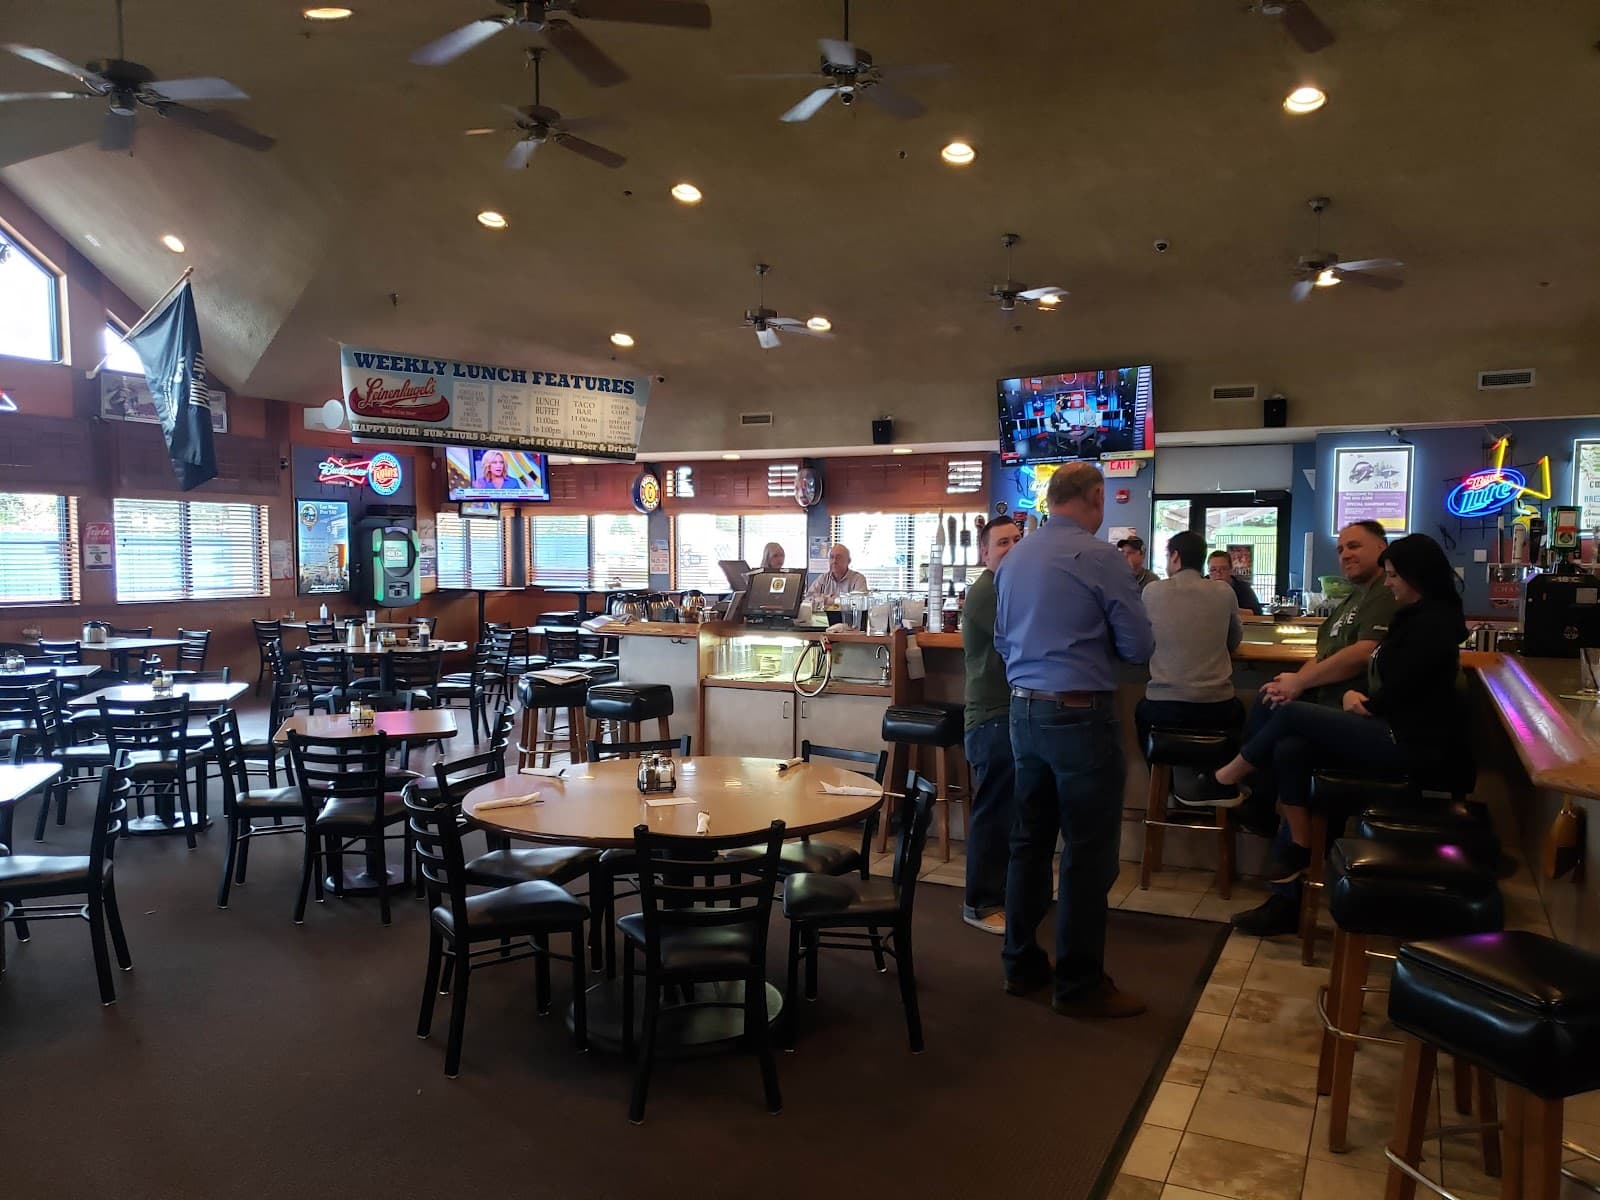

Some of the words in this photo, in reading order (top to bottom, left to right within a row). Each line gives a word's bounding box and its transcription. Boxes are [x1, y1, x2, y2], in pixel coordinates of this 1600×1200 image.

[353, 352, 447, 376] WEEKLY
[453, 363, 527, 384] LUNCH
[532, 371, 635, 395] FEATURES
[536, 396, 560, 407] LUNCH
[572, 400, 596, 409] TACO
[535, 406, 559, 416] BUFFET
[576, 408, 592, 416] BAR
[352, 423, 386, 434] HAPPY
[387, 426, 419, 436] HOUR!
[576, 441, 598, 452] Beer
